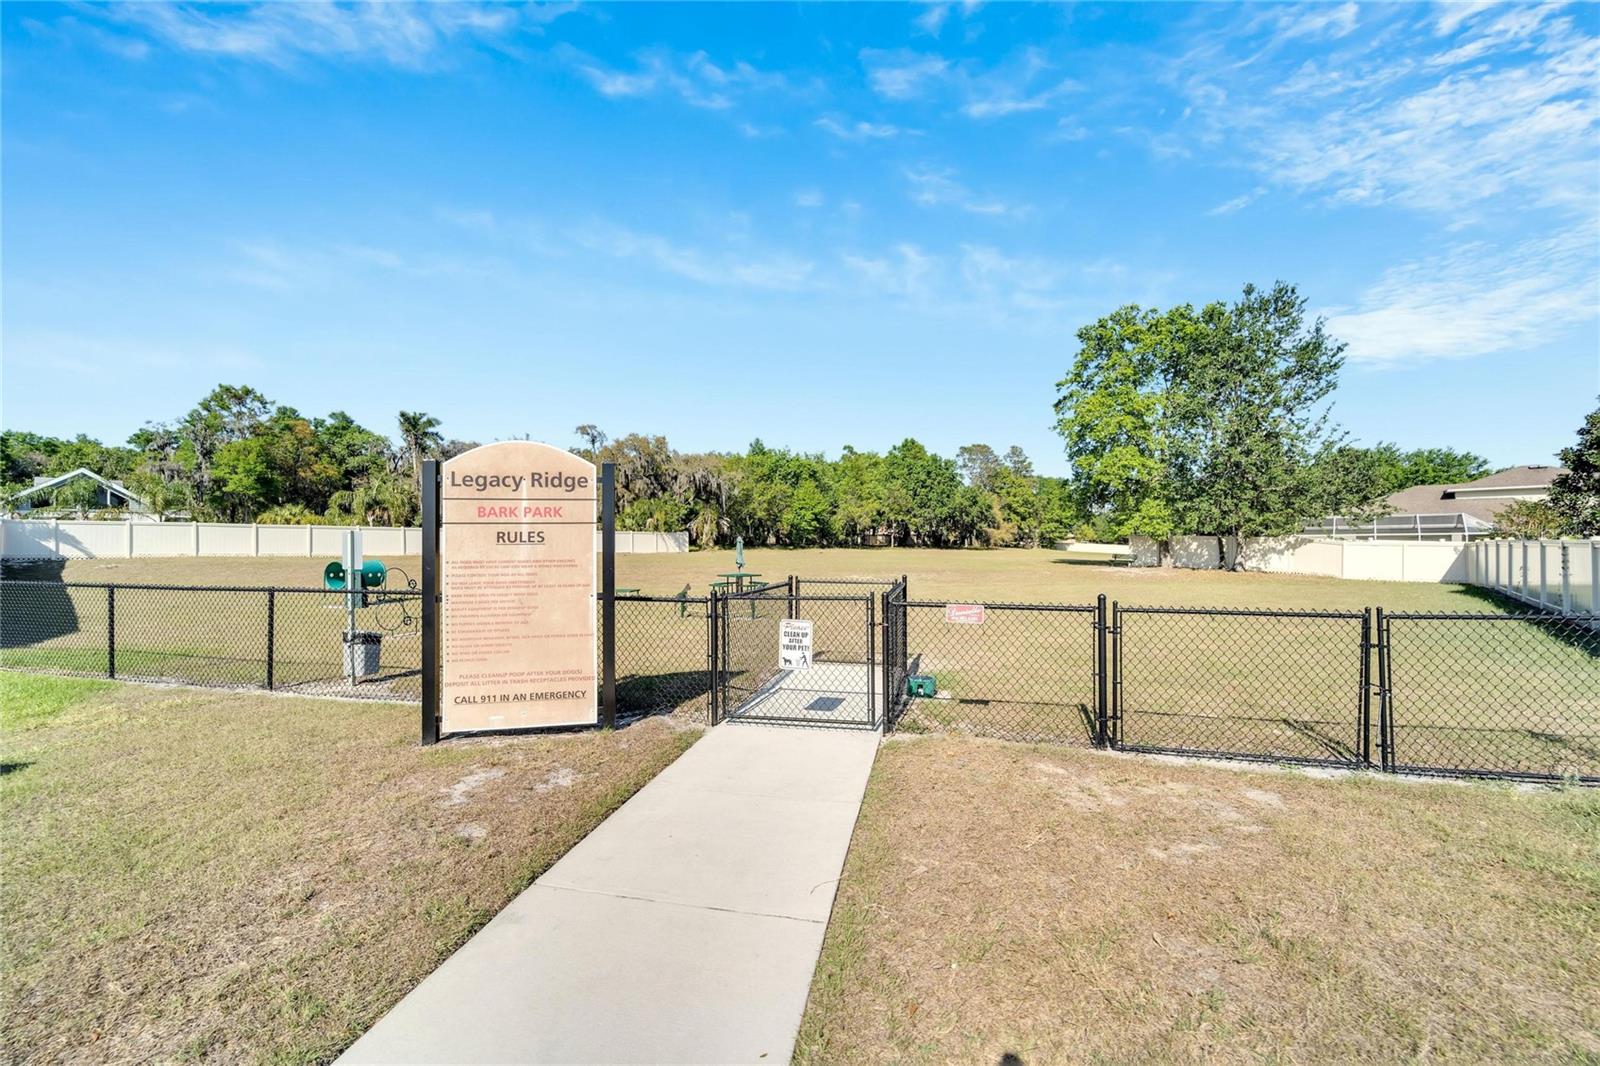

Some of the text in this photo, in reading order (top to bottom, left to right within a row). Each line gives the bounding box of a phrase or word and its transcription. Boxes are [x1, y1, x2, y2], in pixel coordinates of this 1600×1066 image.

[451, 471, 588, 492] Legacy Ridge
[477, 506, 563, 519] BARK PARK
[496, 530, 545, 543] RULES
[454, 690, 587, 704] CALL 911 IN AN EMERGENCY
